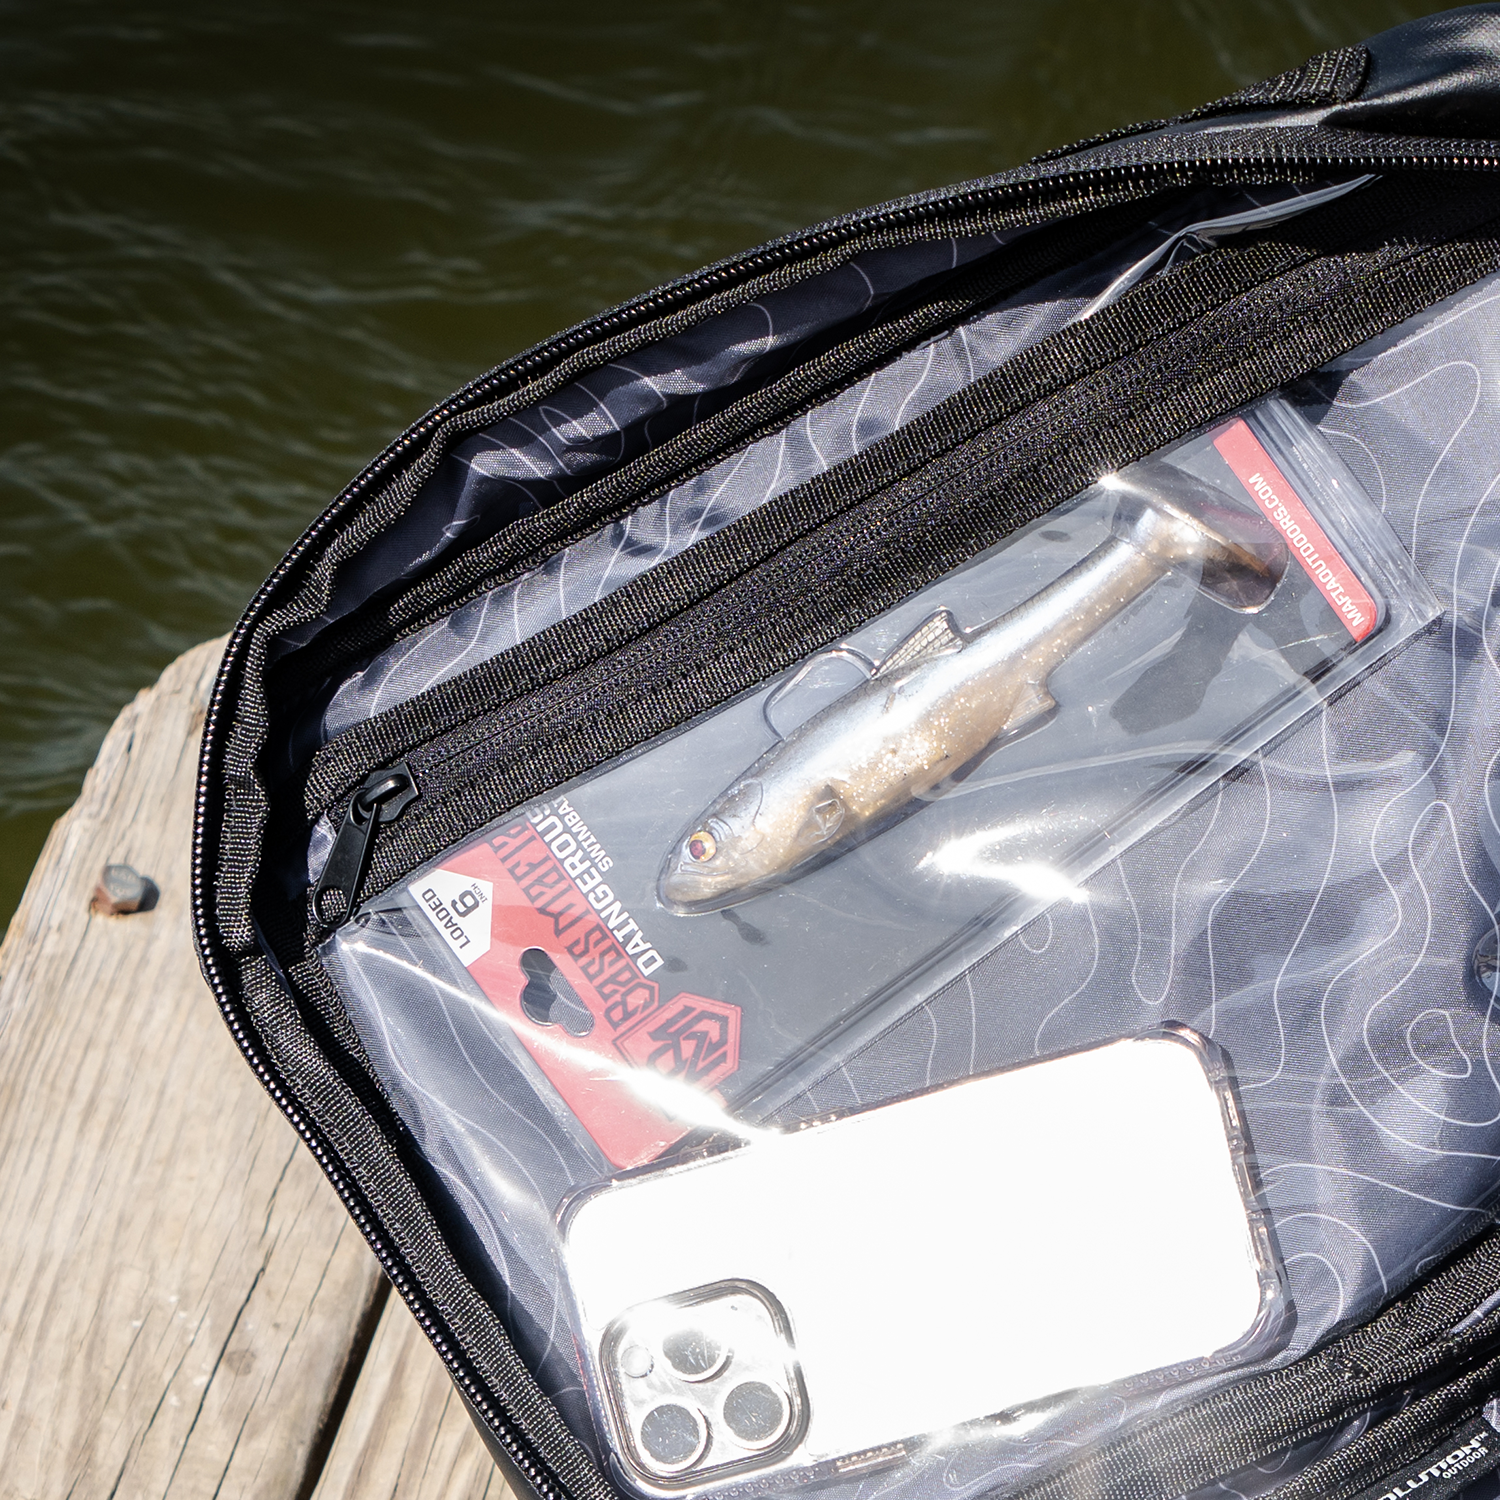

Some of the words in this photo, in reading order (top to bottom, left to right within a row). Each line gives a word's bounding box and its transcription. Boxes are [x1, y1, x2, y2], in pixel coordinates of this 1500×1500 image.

[1248, 472, 1365, 626] MAFIAOUTDOORS.COM
[554, 795, 614, 872] SWIMBAI
[422, 888, 471, 949] LOADED
[451, 890, 480, 918] 6
[470, 882, 488, 903] INCH
[525, 803, 664, 977] DAINGEROUS
[1442, 1446, 1489, 1480] OUTDOOR
